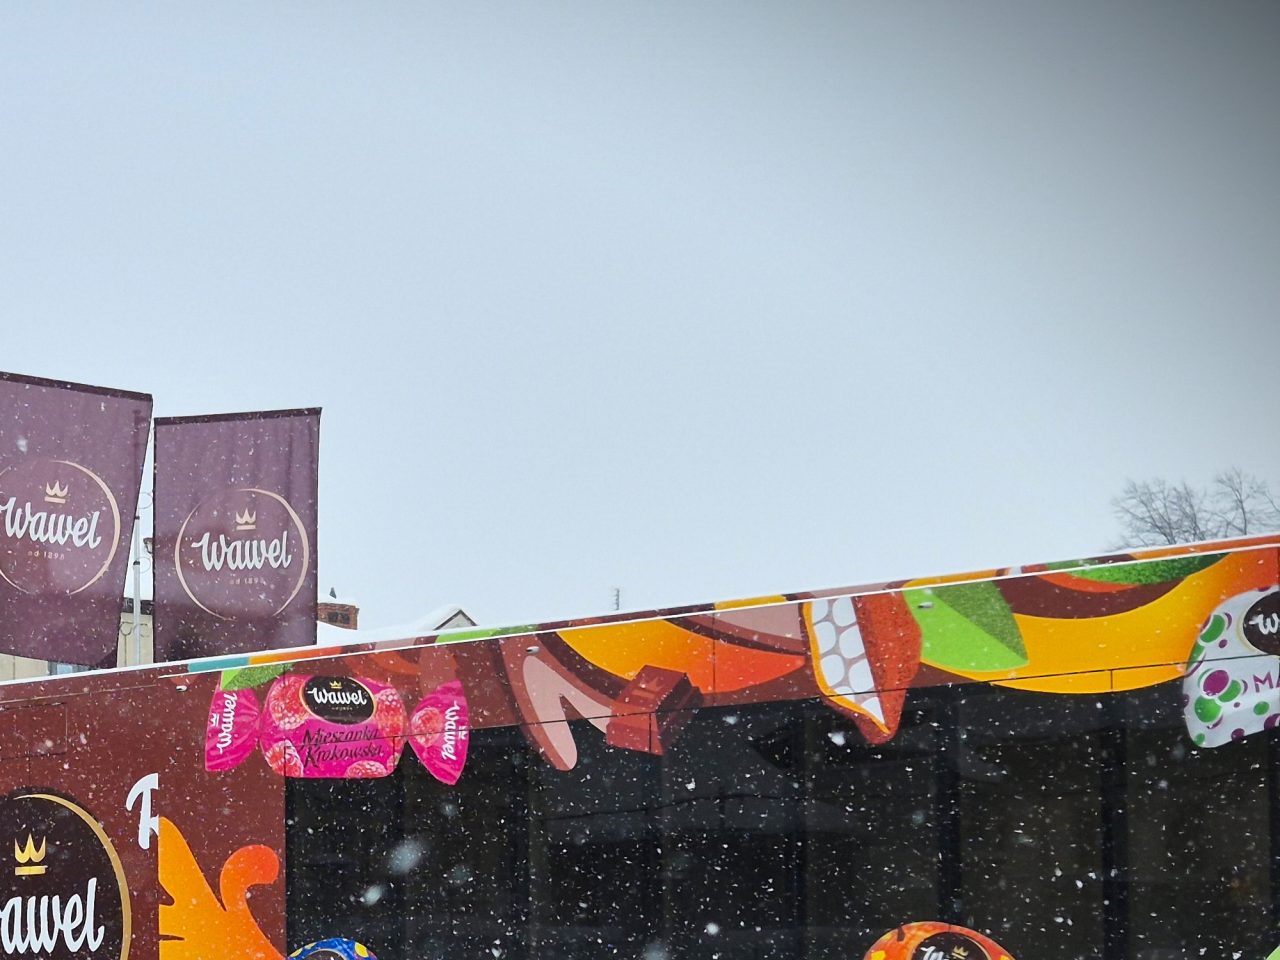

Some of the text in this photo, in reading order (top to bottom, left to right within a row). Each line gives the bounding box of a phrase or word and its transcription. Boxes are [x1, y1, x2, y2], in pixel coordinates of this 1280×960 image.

[191, 530, 292, 571] Wawel
[306, 687, 368, 706] Wawel
[215, 692, 238, 754] Wawel
[301, 725, 380, 750] Mieszanka
[441, 700, 460, 761] Wawel
